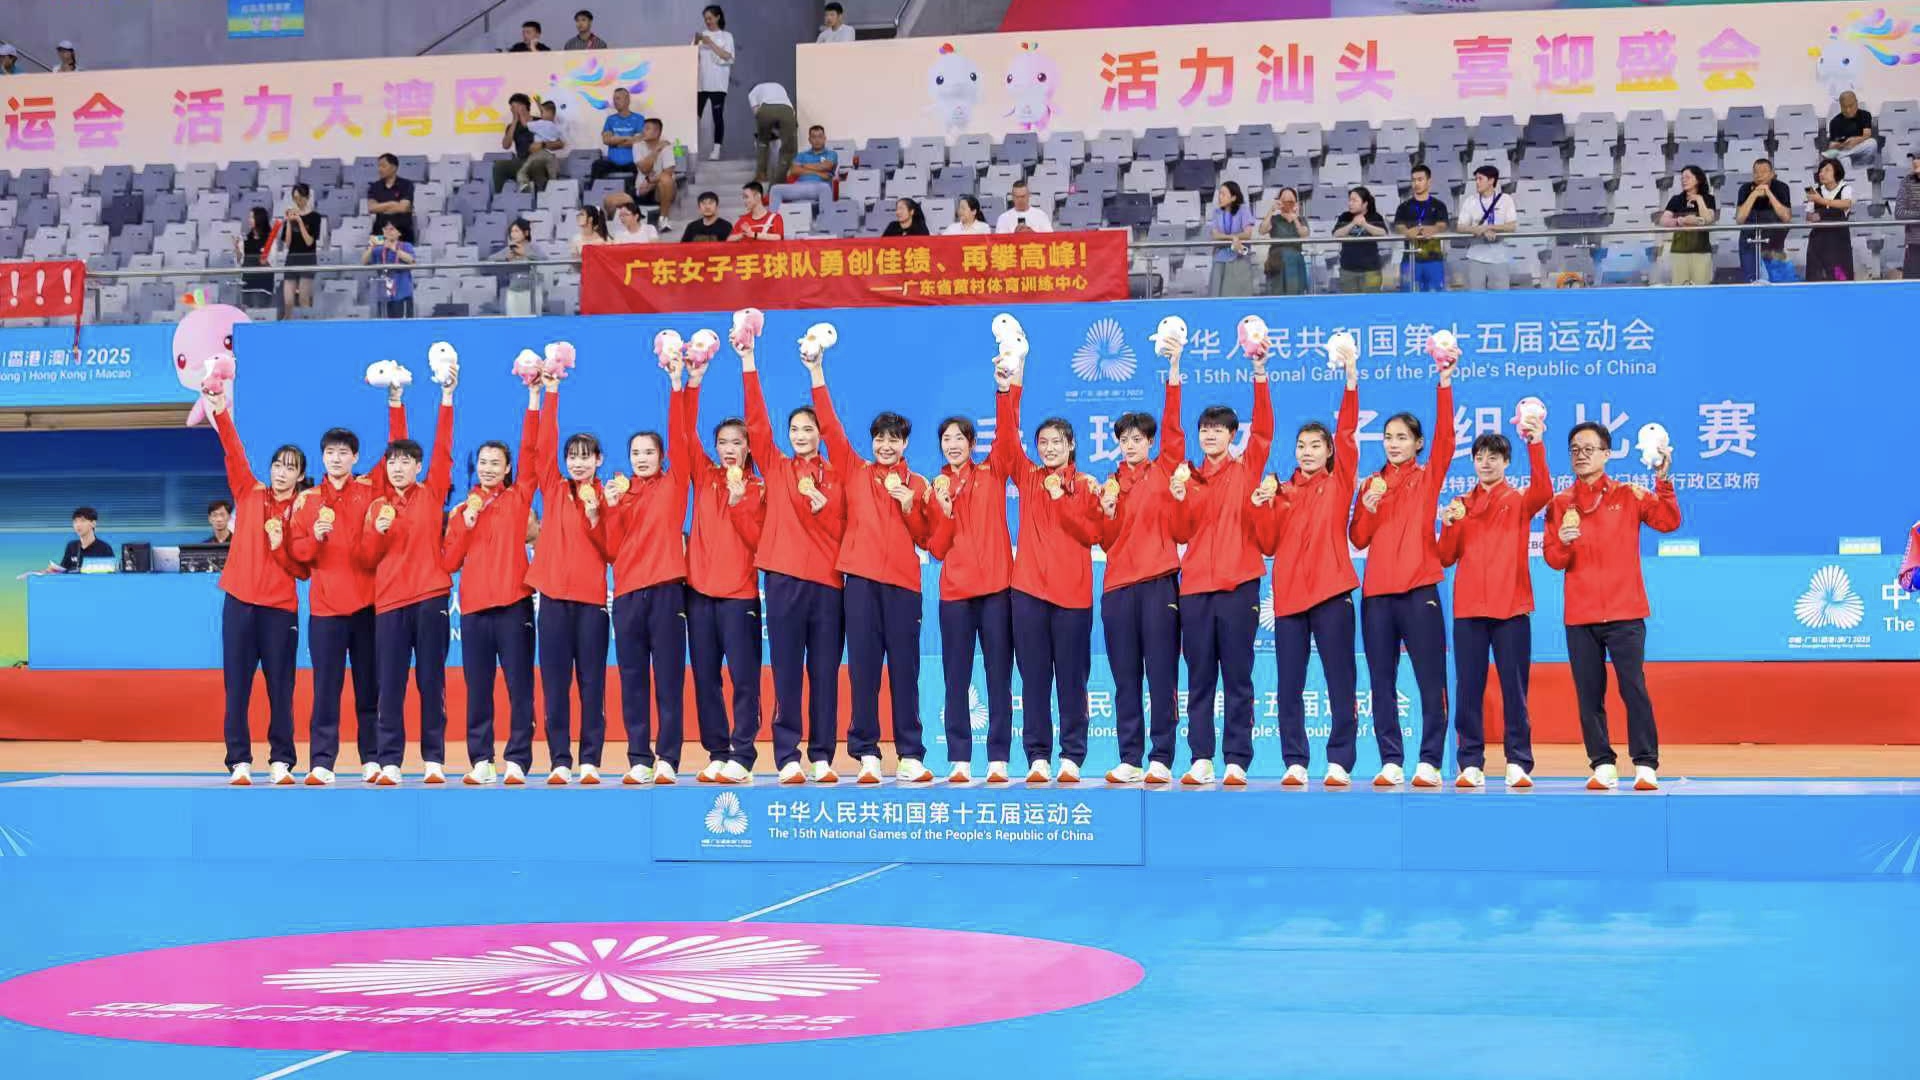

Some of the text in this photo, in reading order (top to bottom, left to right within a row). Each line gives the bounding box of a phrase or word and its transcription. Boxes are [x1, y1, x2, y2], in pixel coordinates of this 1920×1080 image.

[1100, 27, 1761, 112] 活力汕头 喜迎盛会
[5, 77, 506, 150] 运会 活力大湾区
[1157, 317, 1655, 361] 华民共国第五届运动会
[86, 347, 132, 366] 2025
[95, 369, 132, 380] Macao
[1156, 368, 1189, 385] Te
[1194, 366, 1231, 384] 15th
[1235, 364, 1306, 383] Naional
[1374, 361, 1394, 380] of
[1396, 362, 1424, 380] the
[1428, 360, 1500, 381] Pople's
[1504, 359, 1580, 381] Republic
[1584, 359, 1603, 376] of
[1607, 359, 1657, 376] China
[1883, 616, 1916, 632] The
[767, 801, 1093, 826] 中华人民共和国第十五届运动会
[768, 827, 1094, 842] The 15th National Games of the People's Republic of China
[672, 1012, 857, 1024] 2025
